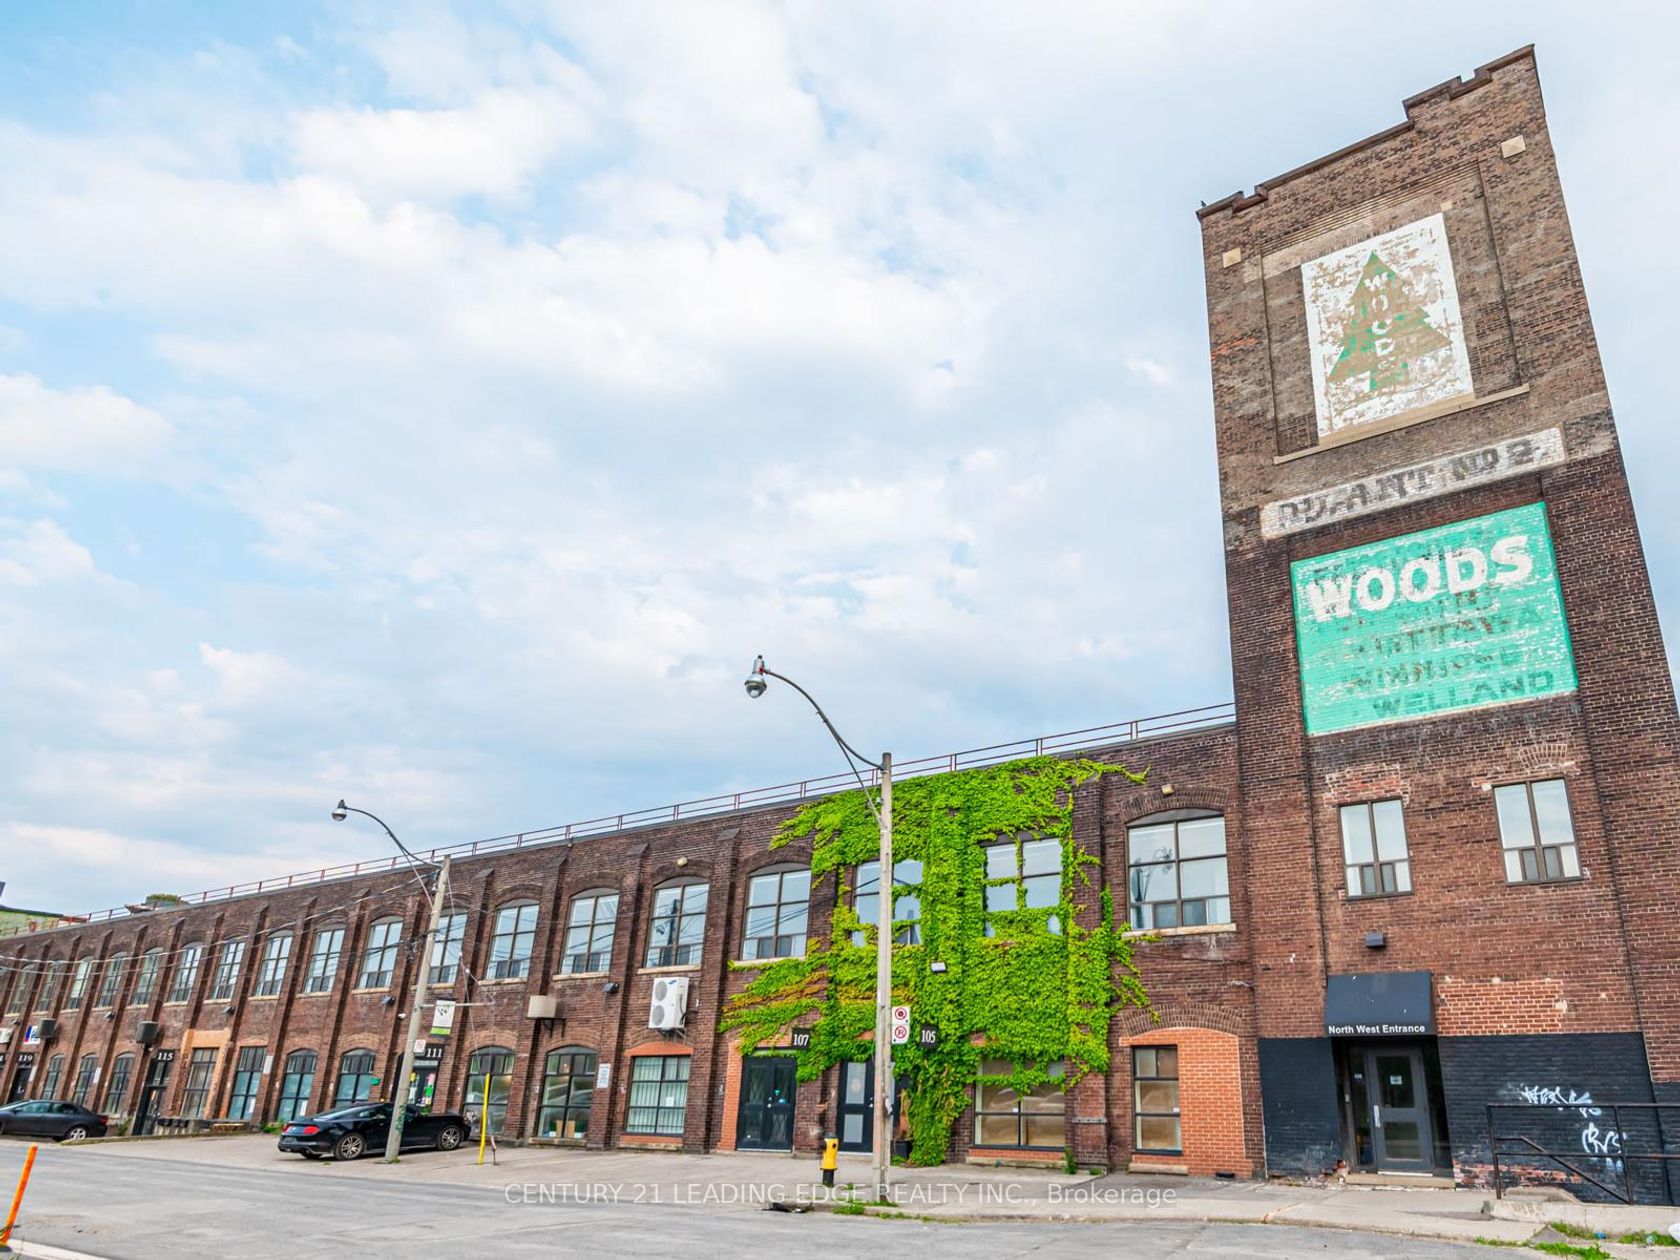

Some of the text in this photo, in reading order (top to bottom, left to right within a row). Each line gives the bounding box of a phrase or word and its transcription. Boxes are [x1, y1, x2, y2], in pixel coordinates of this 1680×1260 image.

[1306, 535, 1534, 623] WOODS
[1328, 1024, 1426, 1034] North West Entrance
[793, 1034, 809, 1046] 107
[921, 1030, 936, 1043] 105
[157, 1052, 174, 1060] 115
[426, 1048, 443, 1058] 111
